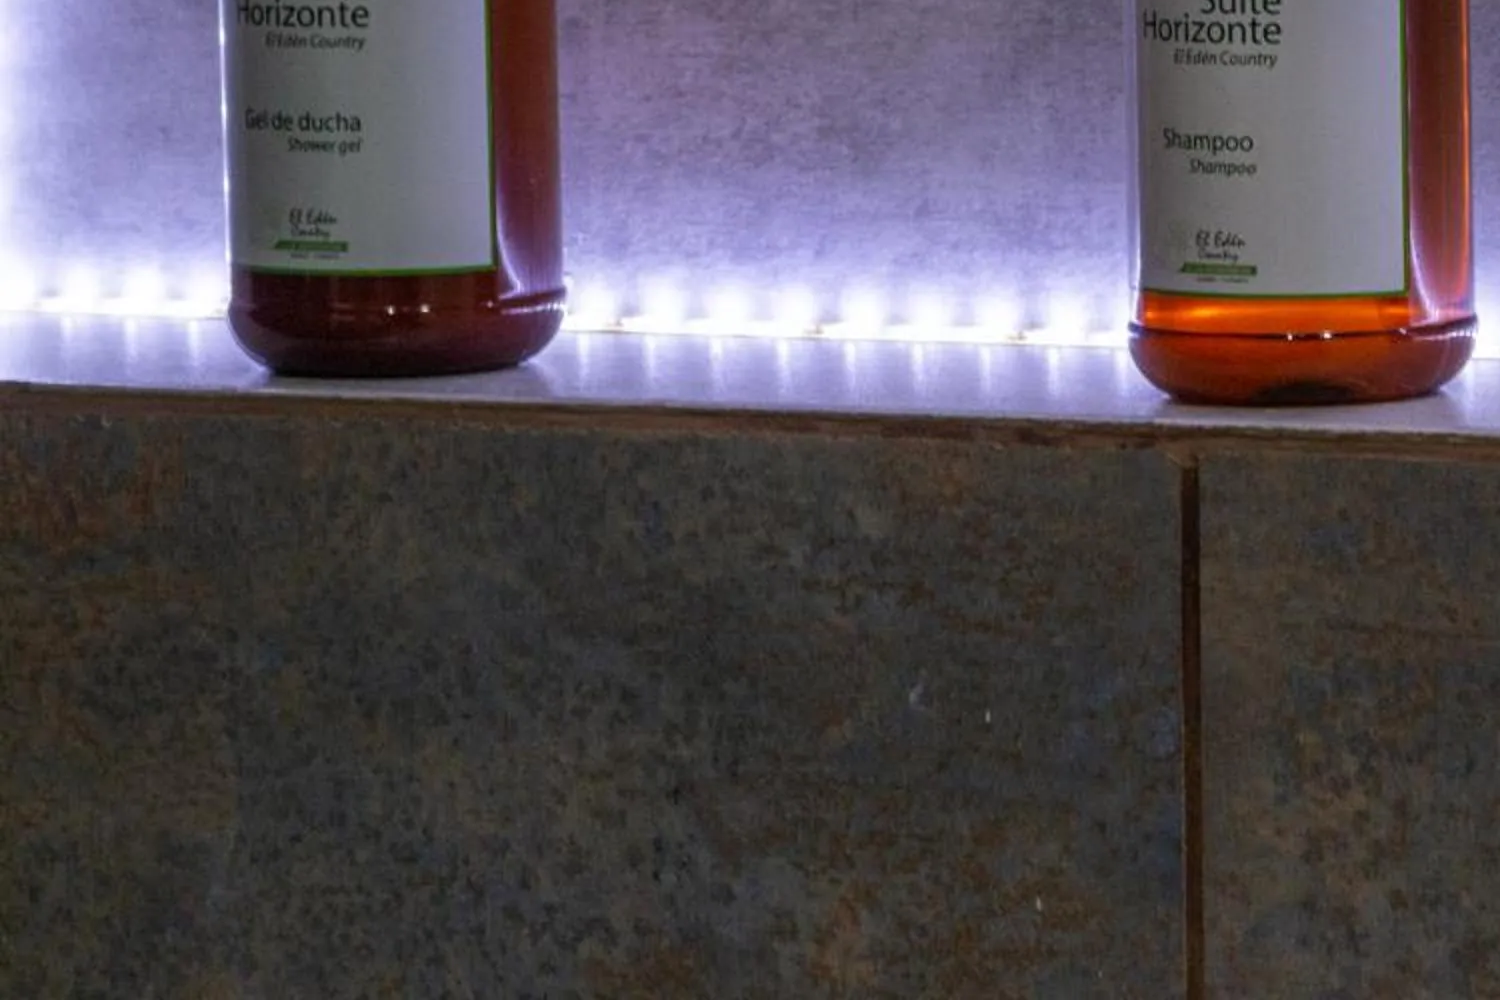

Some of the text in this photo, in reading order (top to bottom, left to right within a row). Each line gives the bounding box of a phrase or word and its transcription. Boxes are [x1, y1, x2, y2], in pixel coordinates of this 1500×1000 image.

[1142, 9, 1281, 45] Horizonte
[310, 33, 366, 51] Country
[1220, 50, 1277, 70] Country
[245, 107, 361, 132] Gel de ducha
[288, 138, 362, 156] Shower gel
[1163, 128, 1254, 154] Shampoo
[1189, 158, 1257, 177] Shampoo
